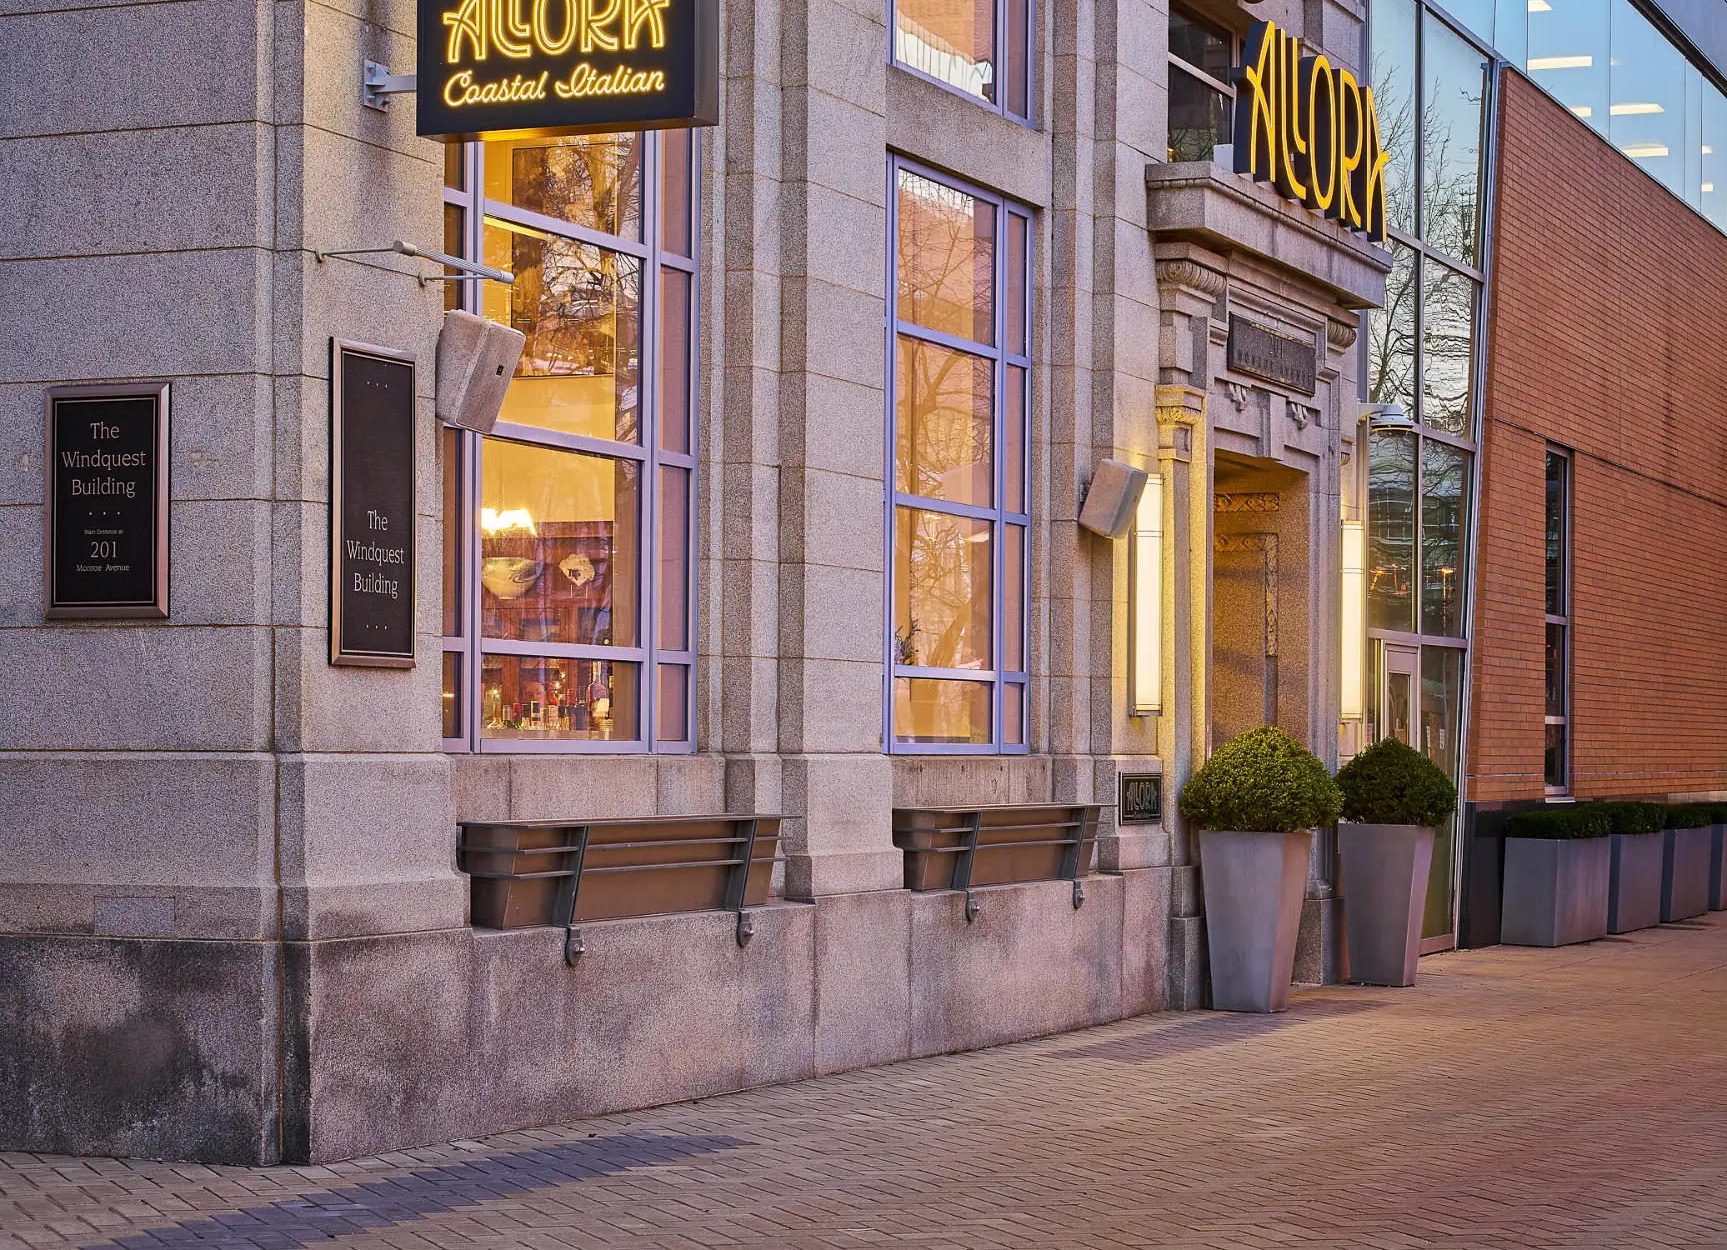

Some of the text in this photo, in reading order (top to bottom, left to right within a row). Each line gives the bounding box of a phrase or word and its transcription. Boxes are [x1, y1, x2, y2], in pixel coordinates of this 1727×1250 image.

[444, 63, 665, 107] Coastal Italian
[1246, 19, 1390, 243] ALLORA
[90, 422, 120, 439] The
[62, 449, 147, 473] Windquest
[72, 477, 136, 498] Building
[367, 510, 388, 531] The
[91, 541, 117, 558] 201
[347, 540, 405, 567] Windquest
[76, 563, 130, 572] Monroe Avenue
[354, 573, 399, 599] Building
[1126, 781, 1158, 811] ALLORA
